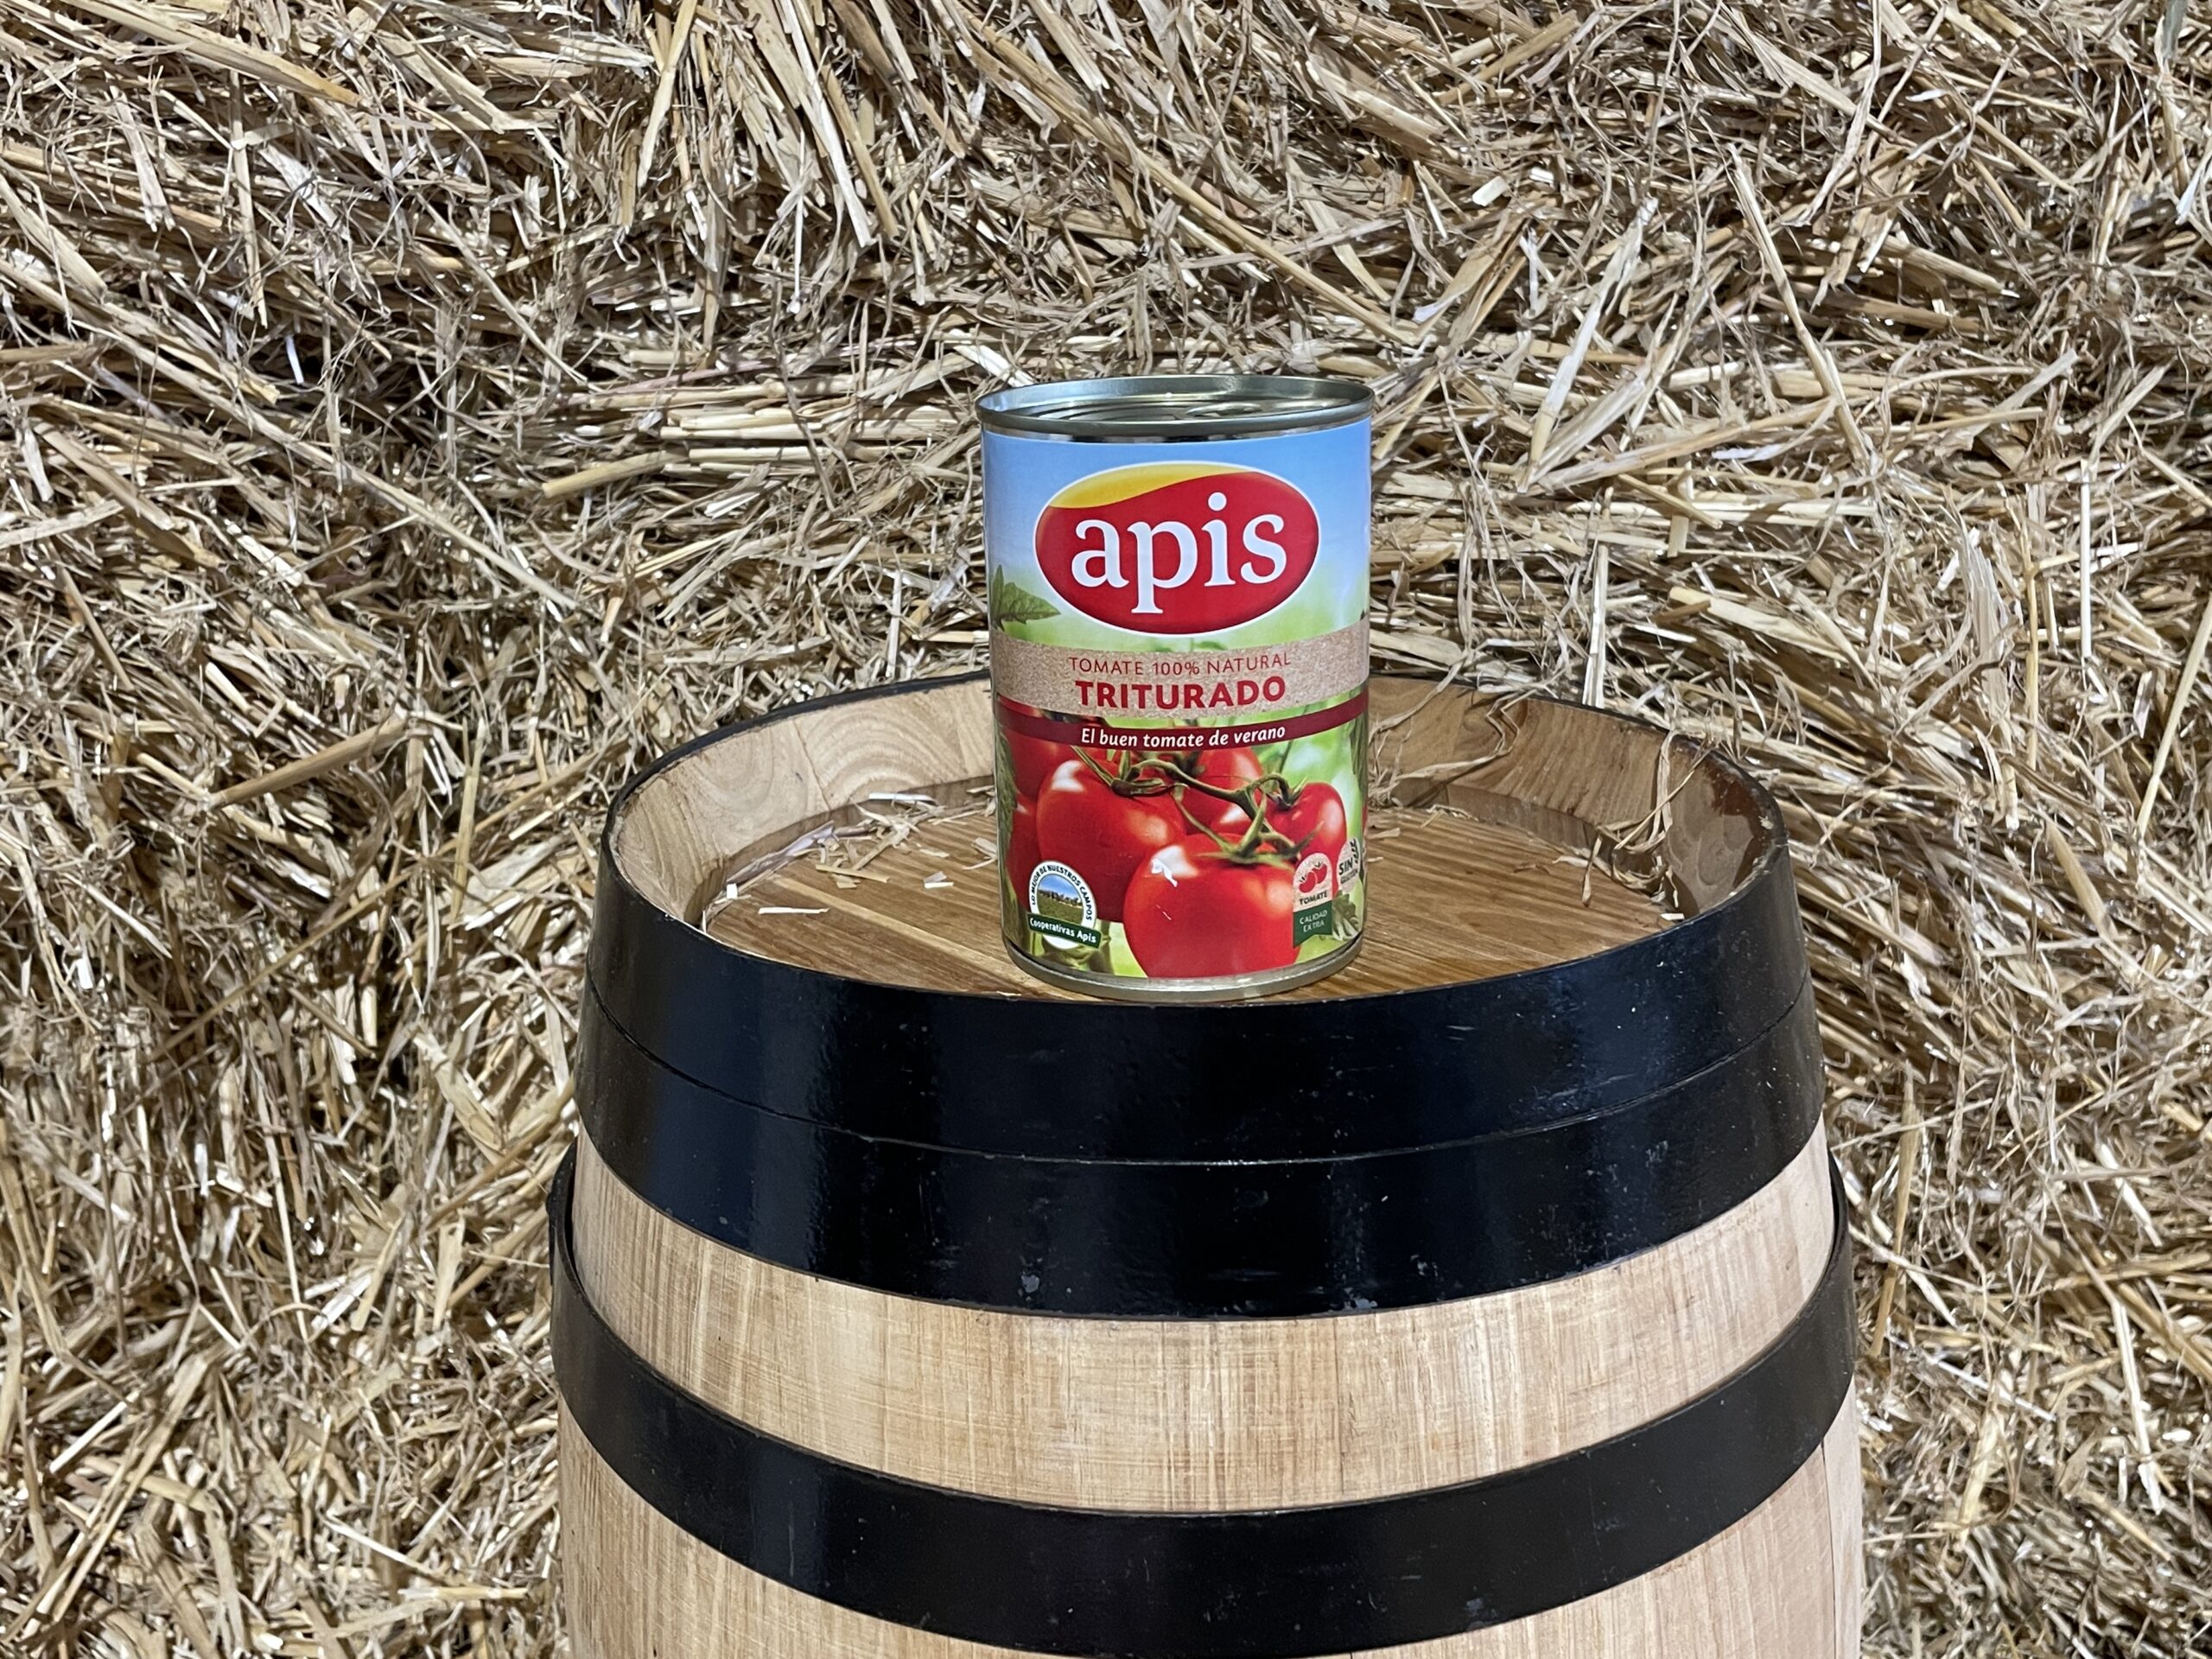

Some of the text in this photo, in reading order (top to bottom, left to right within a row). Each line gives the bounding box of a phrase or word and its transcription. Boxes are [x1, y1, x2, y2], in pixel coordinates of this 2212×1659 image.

[1071, 491, 1287, 614] apis
[1068, 652, 1291, 676] TOMATE 100% NATURAL
[1074, 676, 1287, 709] TRITURADO
[1080, 726, 1286, 748] El buen tomate de verano
[1338, 857, 1353, 875] SIN
[1031, 871, 1041, 895] MEJOR
[1039, 865, 1047, 874] DE
[1046, 864, 1081, 887] NUESTROS
[1079, 887, 1092, 921] CAMPOS
[1299, 890, 1328, 906] TOMATE
[1299, 909, 1328, 925] CALIDAD
[1302, 919, 1325, 932] EXTRA
[1029, 917, 1096, 944] Cooperativas Apis
